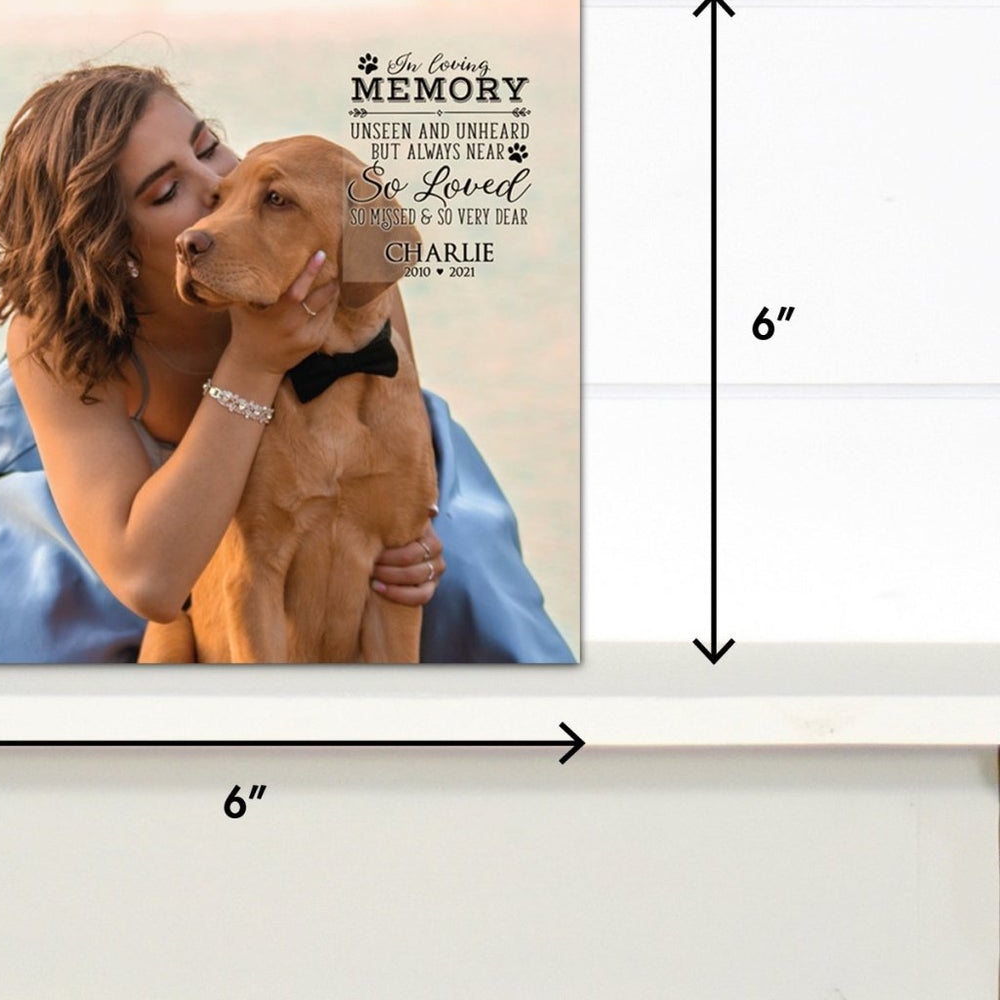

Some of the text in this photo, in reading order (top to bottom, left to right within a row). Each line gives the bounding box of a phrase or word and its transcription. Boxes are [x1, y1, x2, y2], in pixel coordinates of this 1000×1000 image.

[387, 52, 490, 77] In loving
[351, 77, 530, 103] MEMORY
[350, 122, 530, 140] UNSEEN AND UNHEARD
[371, 143, 505, 160] BUT ALWAYS NEAR
[347, 160, 532, 208] So Loved
[350, 208, 529, 231] SO MISSED & SO VERY DEAR
[384, 242, 495, 264] CHARLIE
[404, 266, 476, 278] 2010 2021
